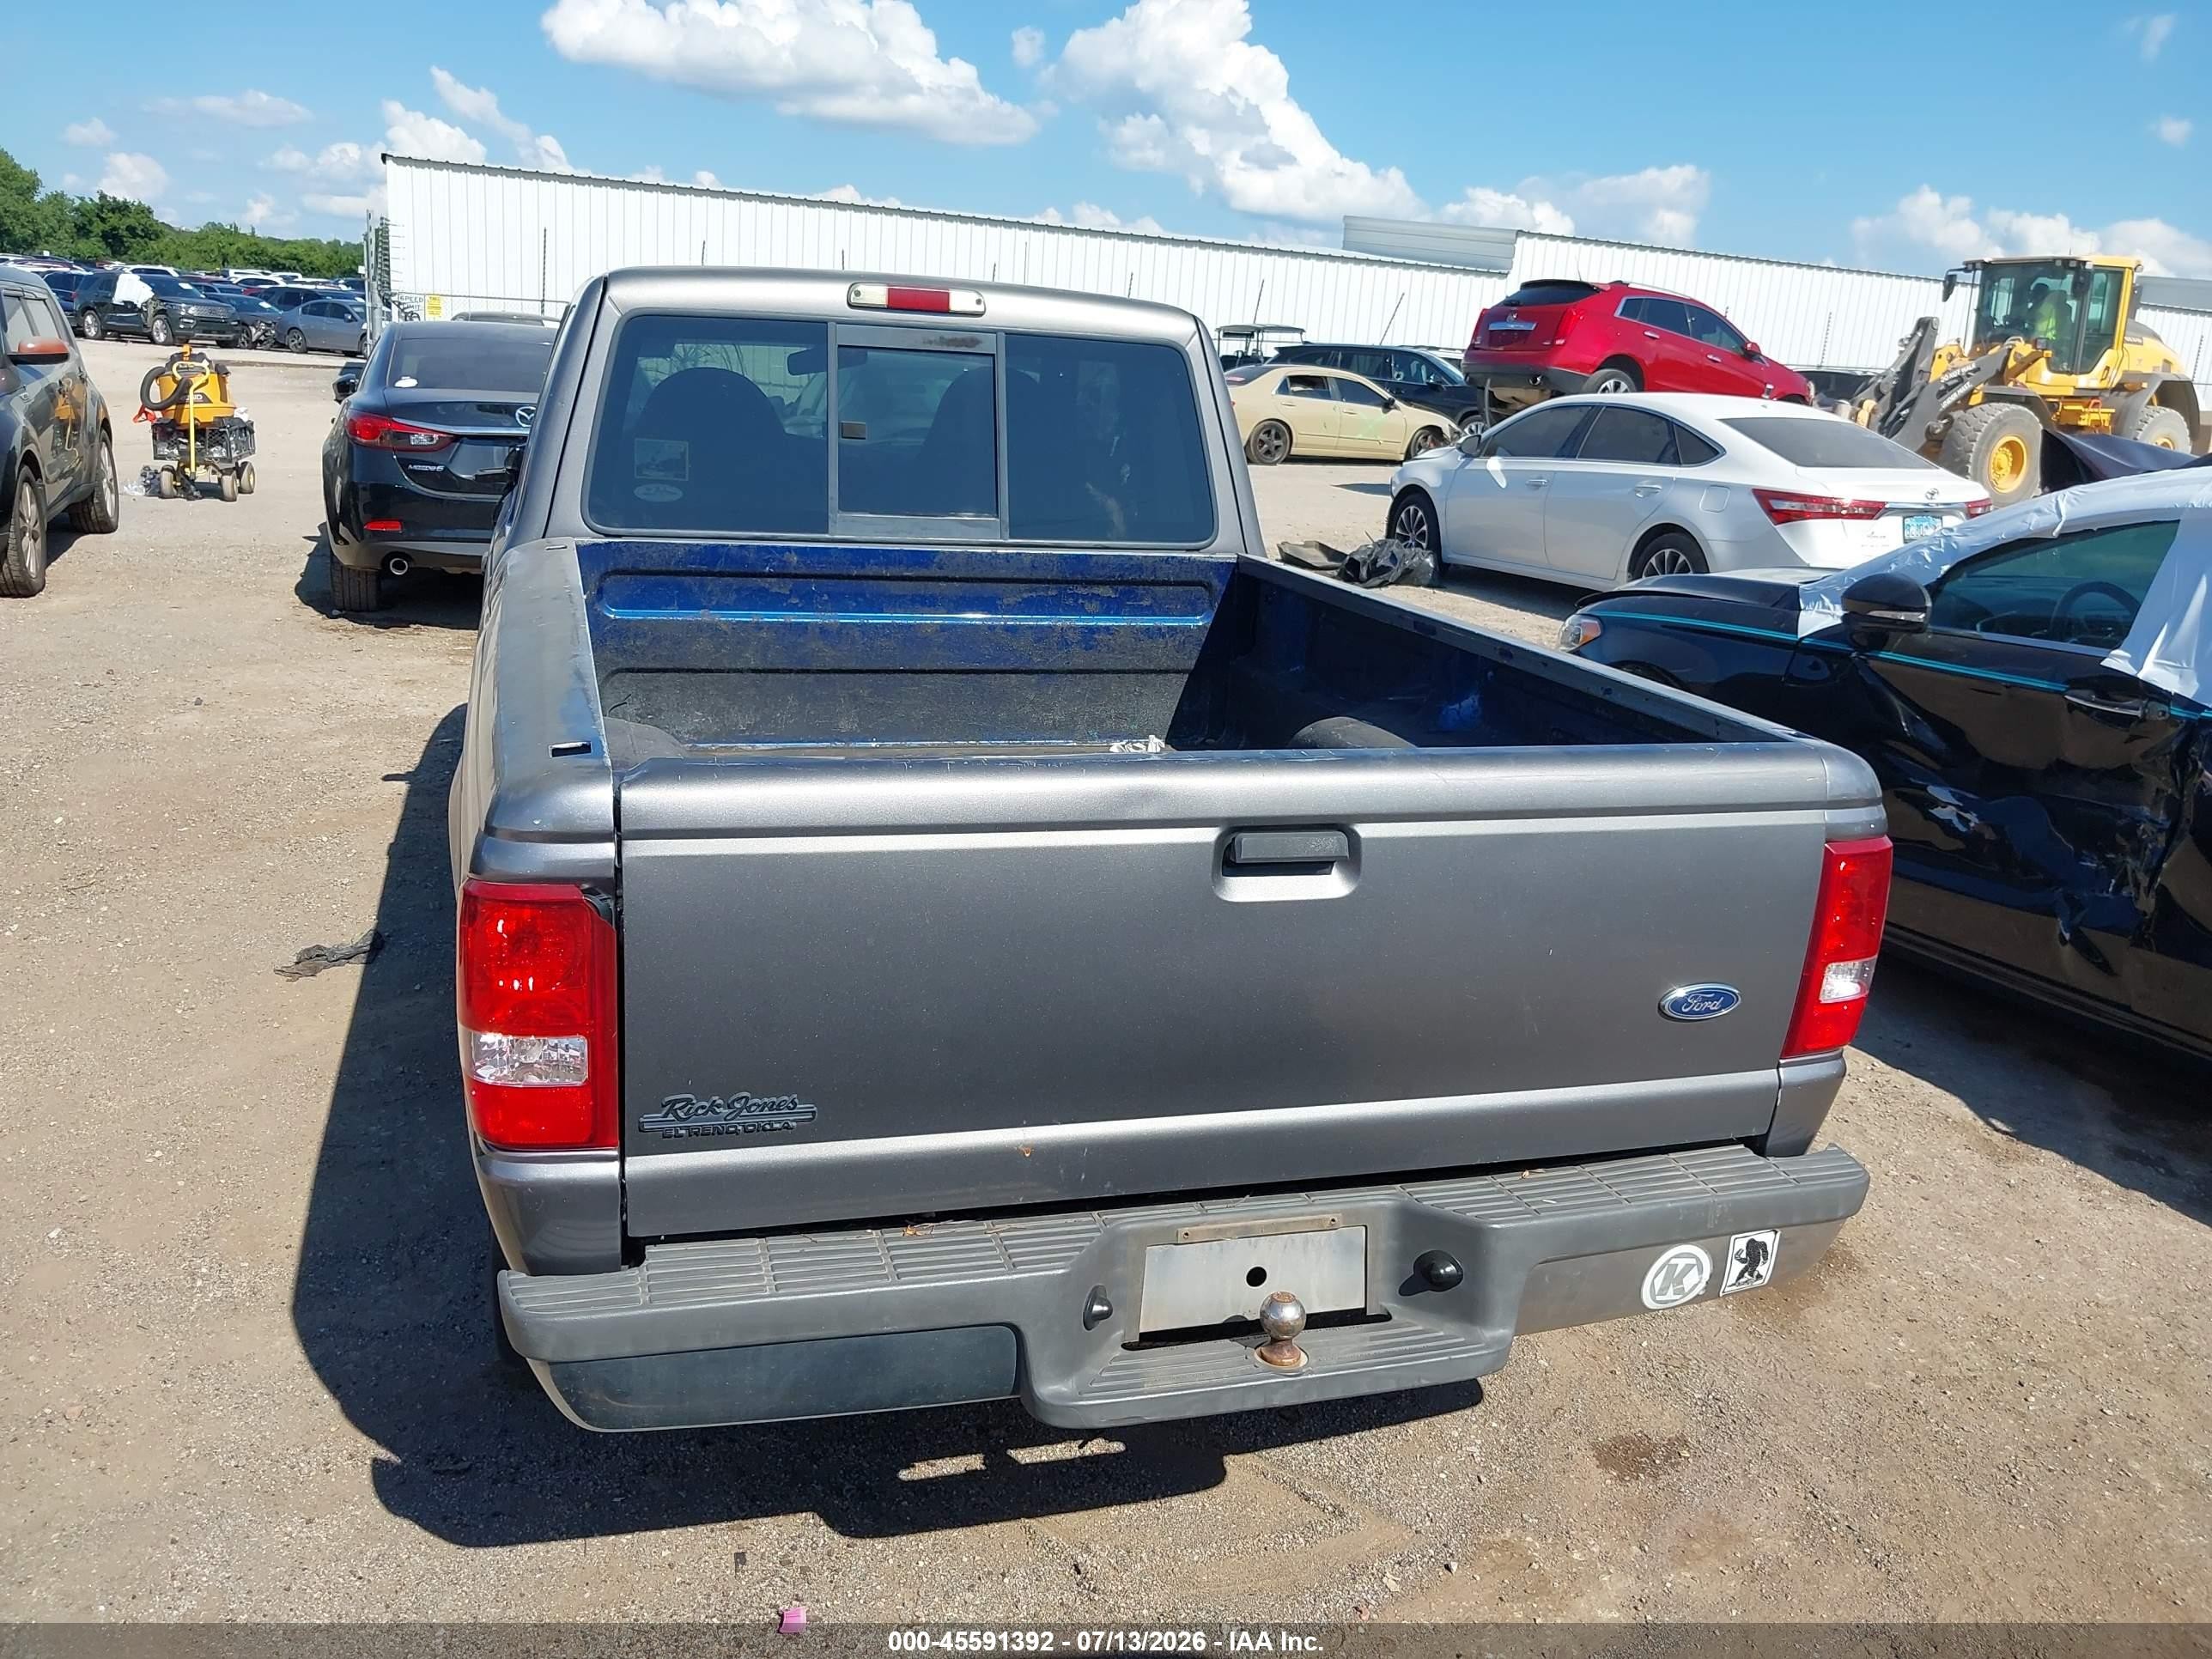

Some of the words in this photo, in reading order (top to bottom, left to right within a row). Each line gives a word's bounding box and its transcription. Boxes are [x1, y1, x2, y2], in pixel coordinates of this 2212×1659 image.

[1681, 993, 1724, 1012] Ford
[660, 1093, 725, 1122] Rick
[724, 1091, 799, 1122] Jones
[661, 1127, 685, 1139] EL
